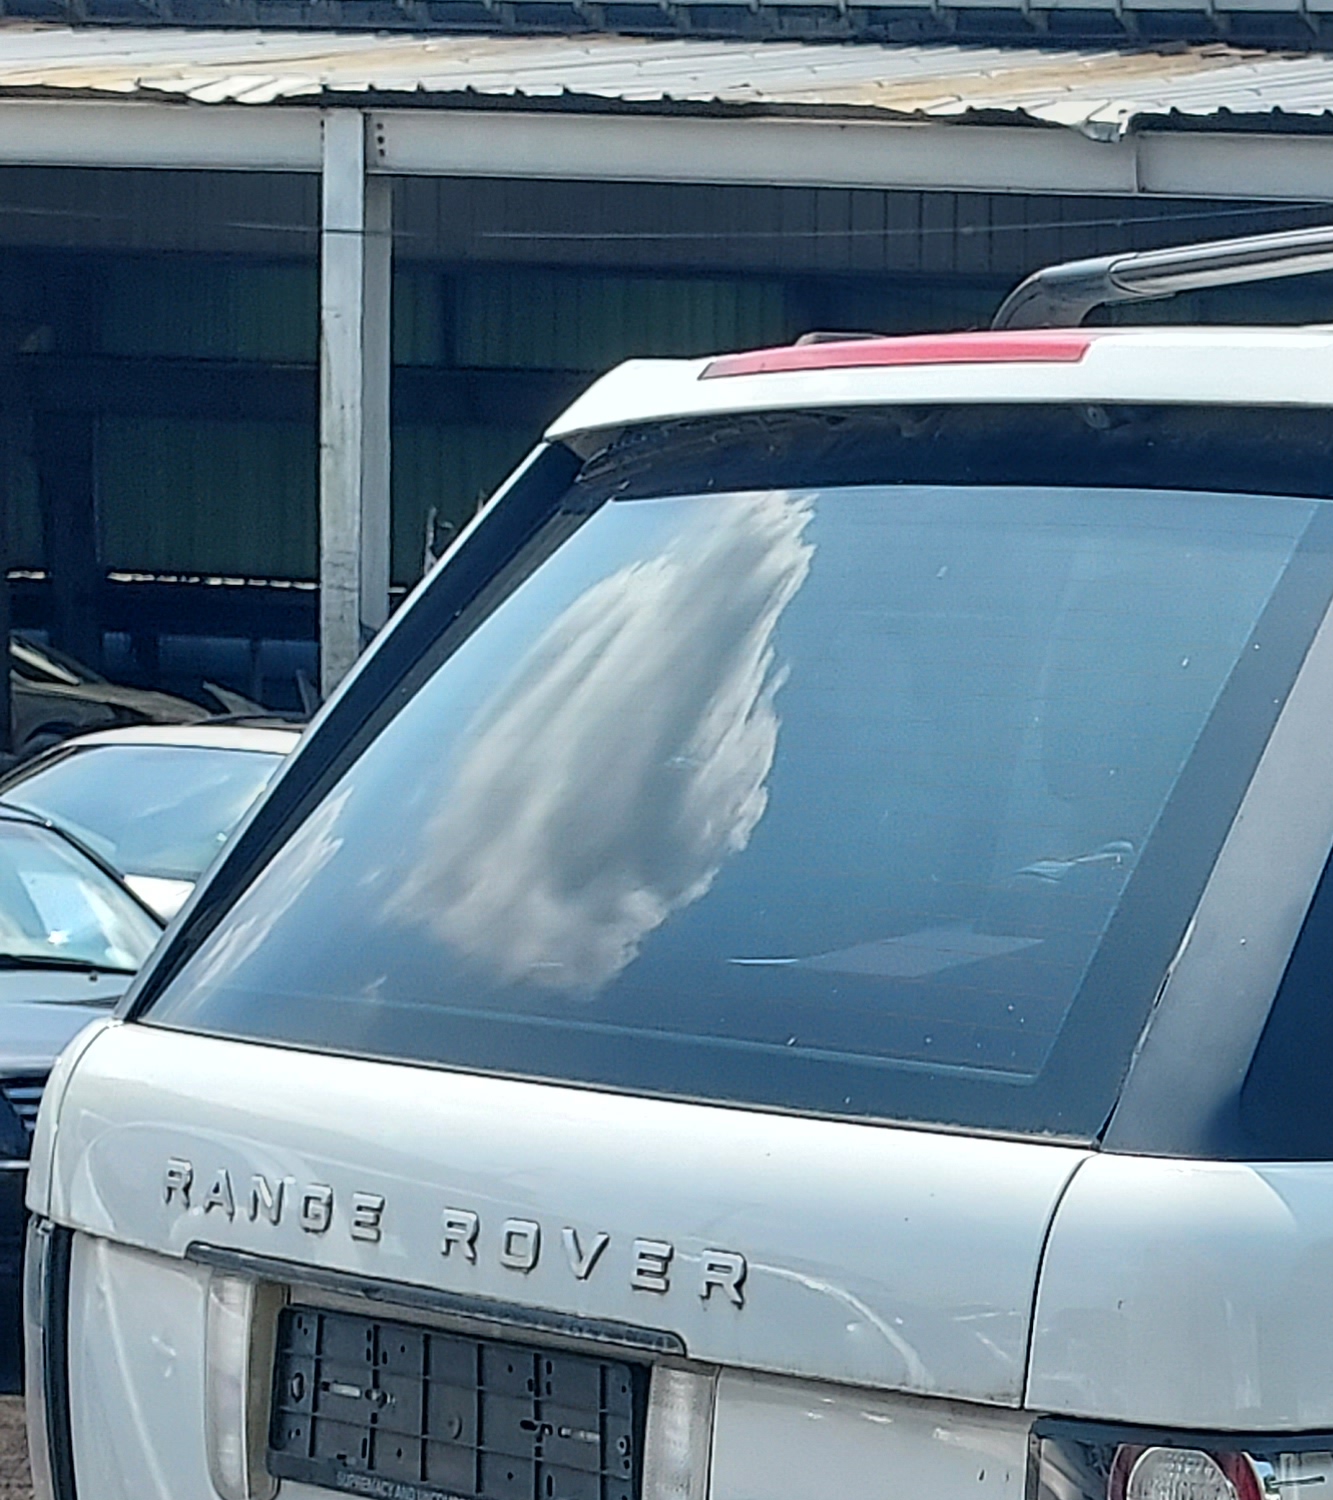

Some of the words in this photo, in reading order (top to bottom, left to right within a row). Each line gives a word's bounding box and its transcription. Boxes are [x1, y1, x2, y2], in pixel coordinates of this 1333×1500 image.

[164, 1157, 386, 1243] RANGE
[441, 1207, 748, 1310] ROVER
[336, 1470, 396, 1498] SUPREMACY
